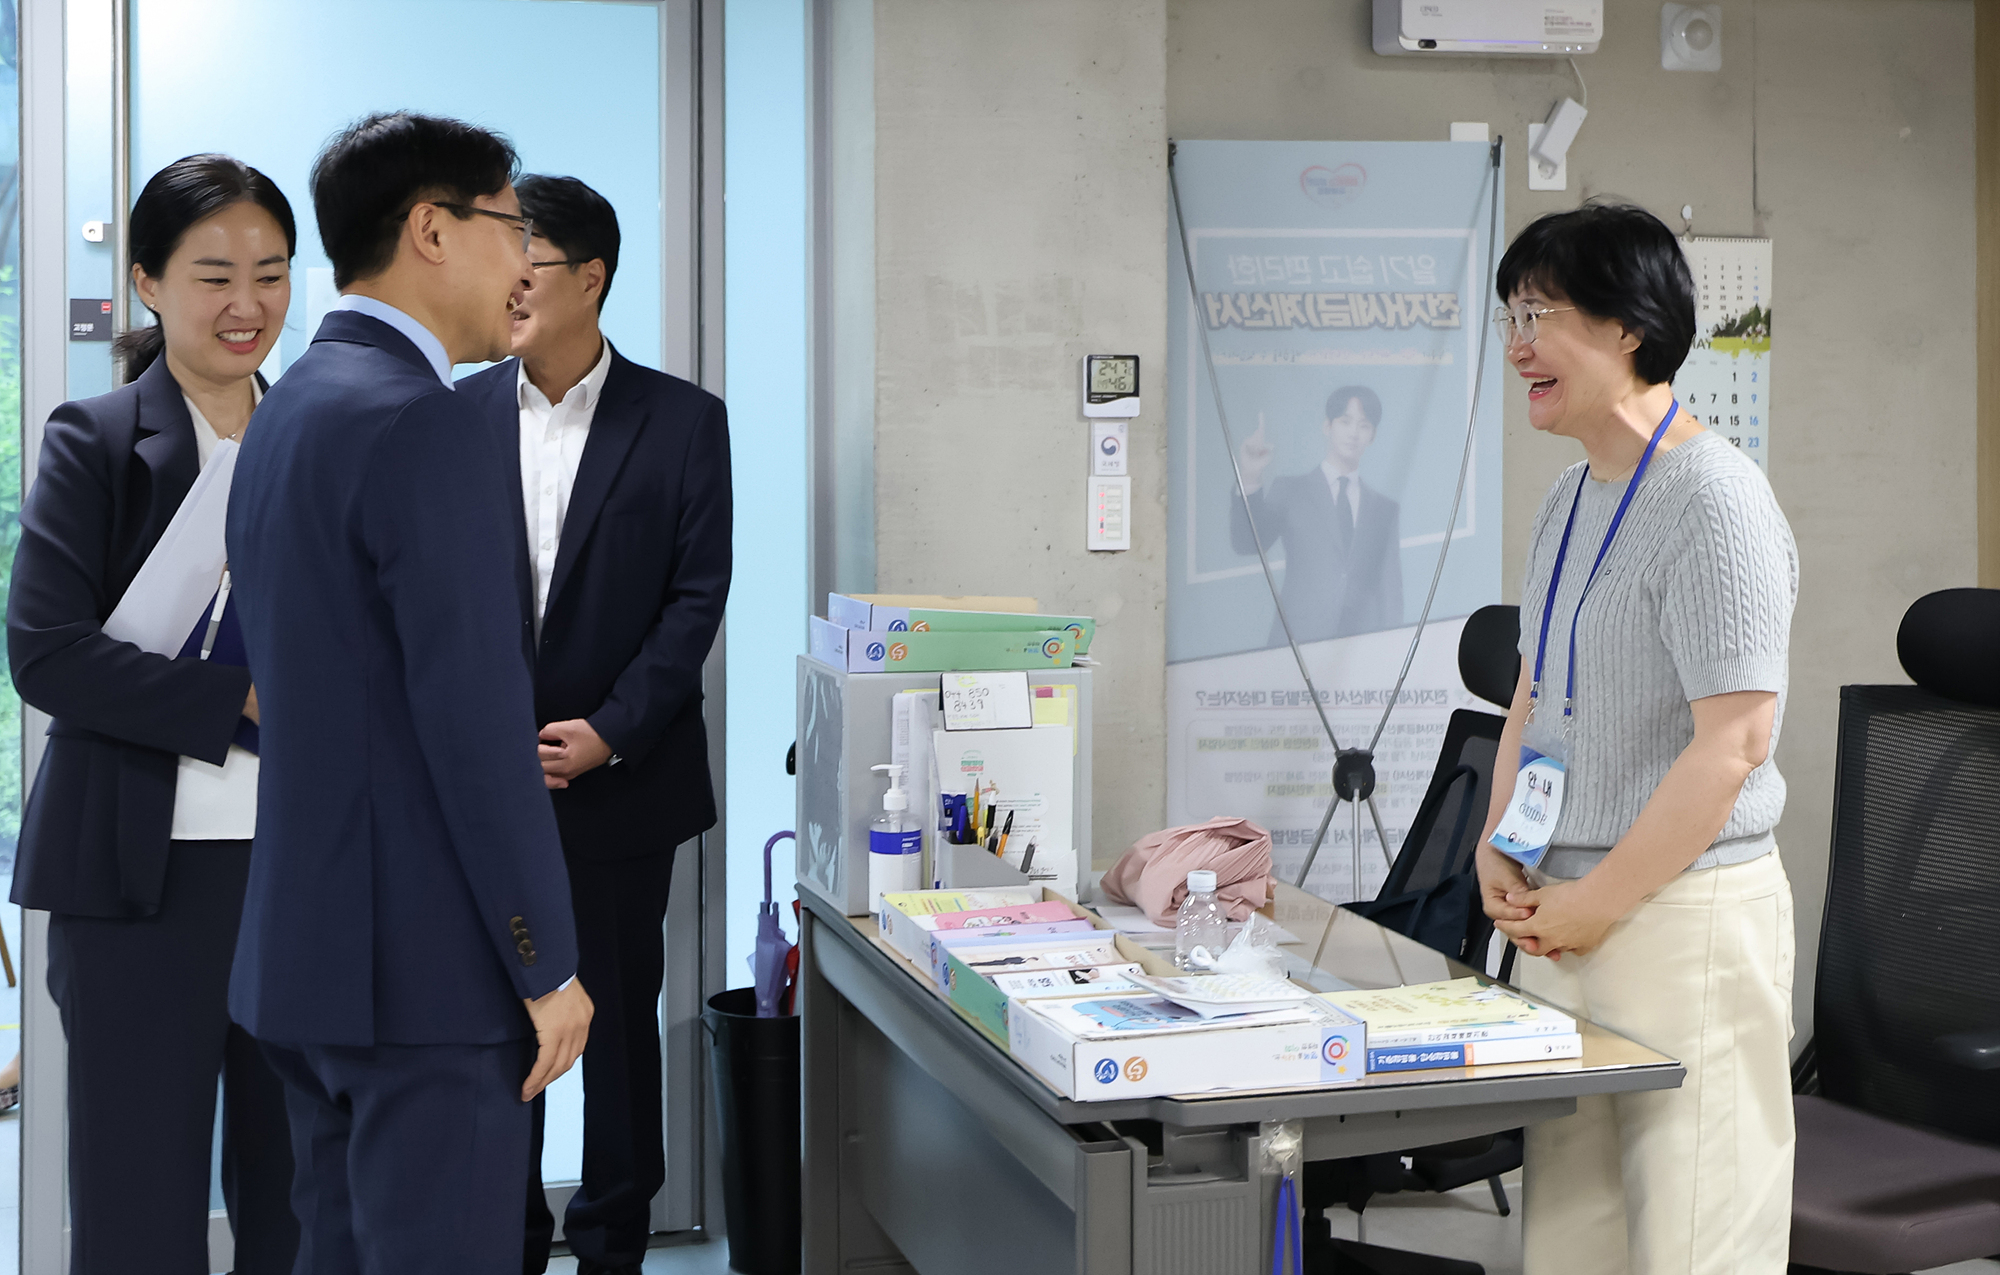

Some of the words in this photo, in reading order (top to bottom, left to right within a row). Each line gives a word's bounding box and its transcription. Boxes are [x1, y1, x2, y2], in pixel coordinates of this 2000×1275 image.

[1732, 371, 1737, 382] 1
[1751, 371, 1758, 382] 2
[1689, 393, 1696, 404] 6
[1710, 393, 1717, 404] 7
[1731, 393, 1738, 404] 8
[1751, 393, 1758, 404] 9
[1708, 415, 1719, 426] 14
[1729, 415, 1740, 426] 15
[1749, 416, 1759, 426] 16
[1748, 437, 1759, 448] 23
[968, 687, 989, 699] 850
[1518, 803, 1548, 826] GUIDE
